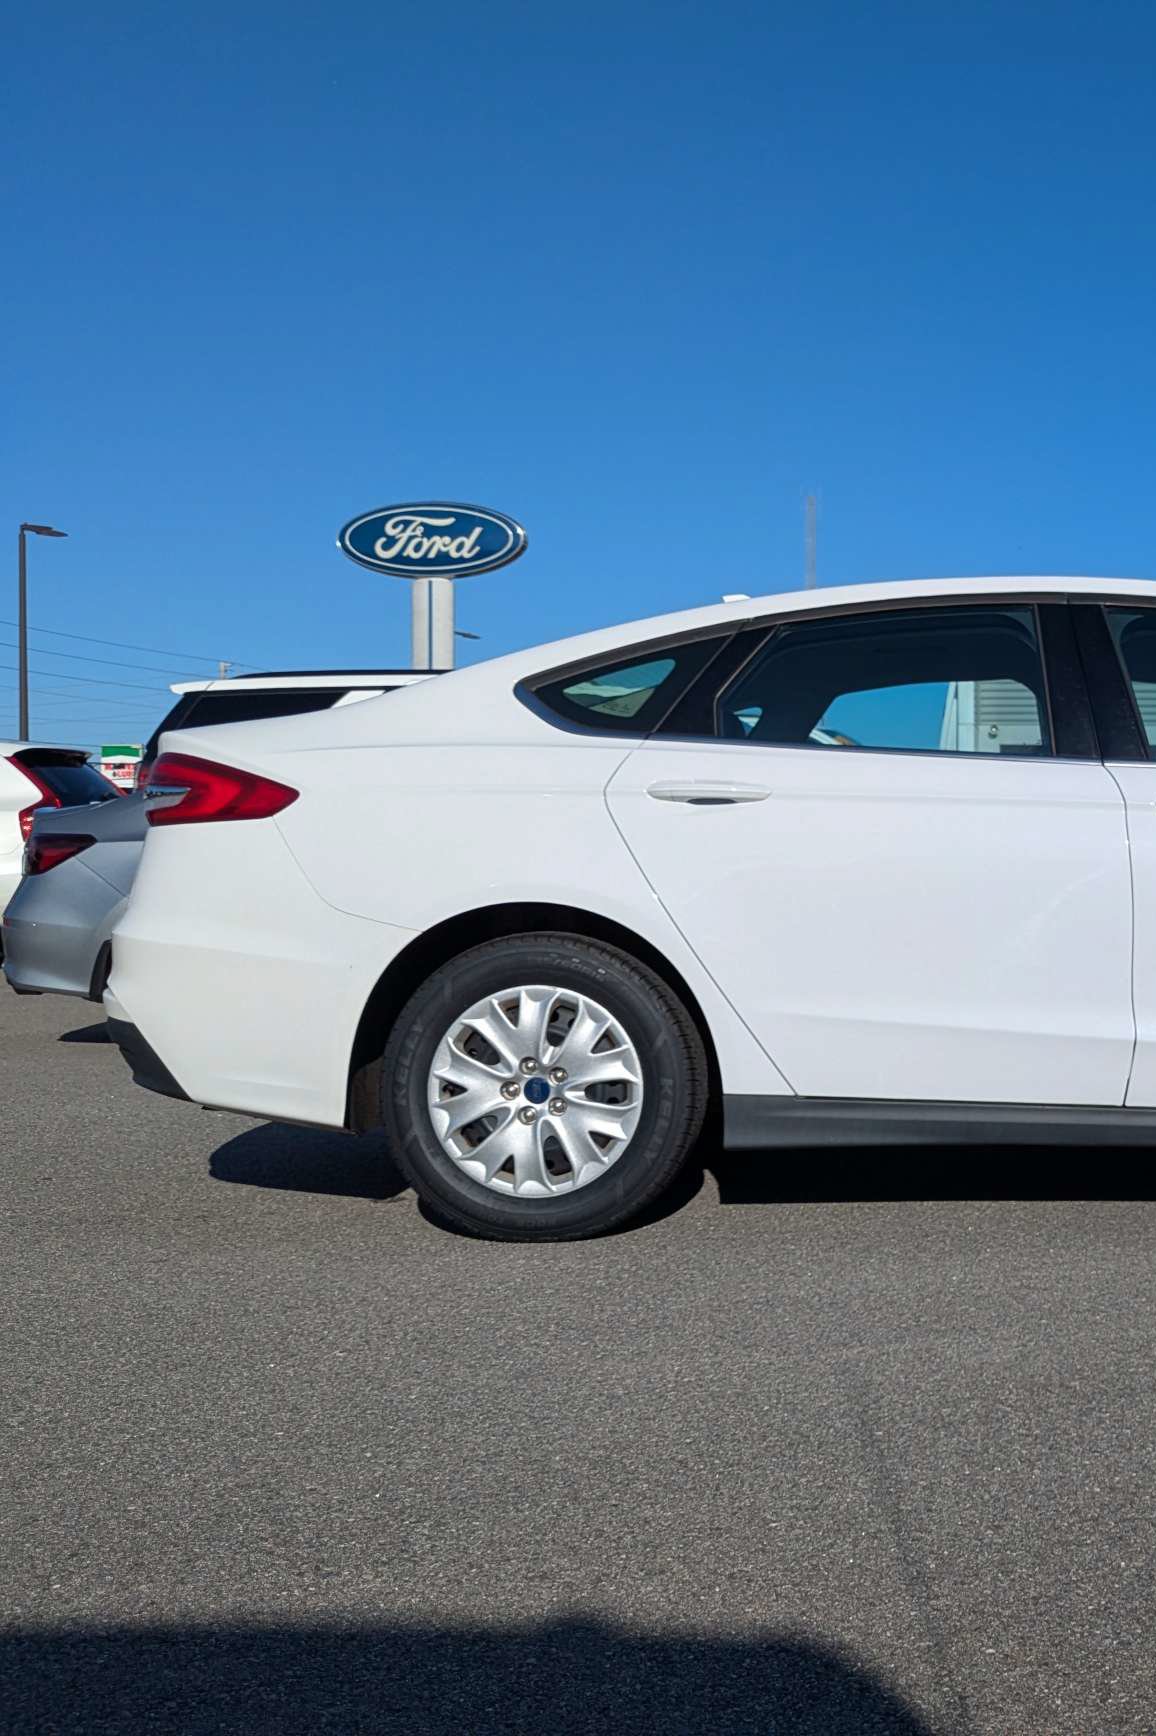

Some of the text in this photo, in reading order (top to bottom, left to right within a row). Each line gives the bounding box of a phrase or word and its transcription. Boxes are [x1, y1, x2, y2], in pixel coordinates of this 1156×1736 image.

[374, 515, 484, 559] Ford
[394, 1018, 424, 1106] KELLY
[643, 1078, 673, 1166] KELLY
